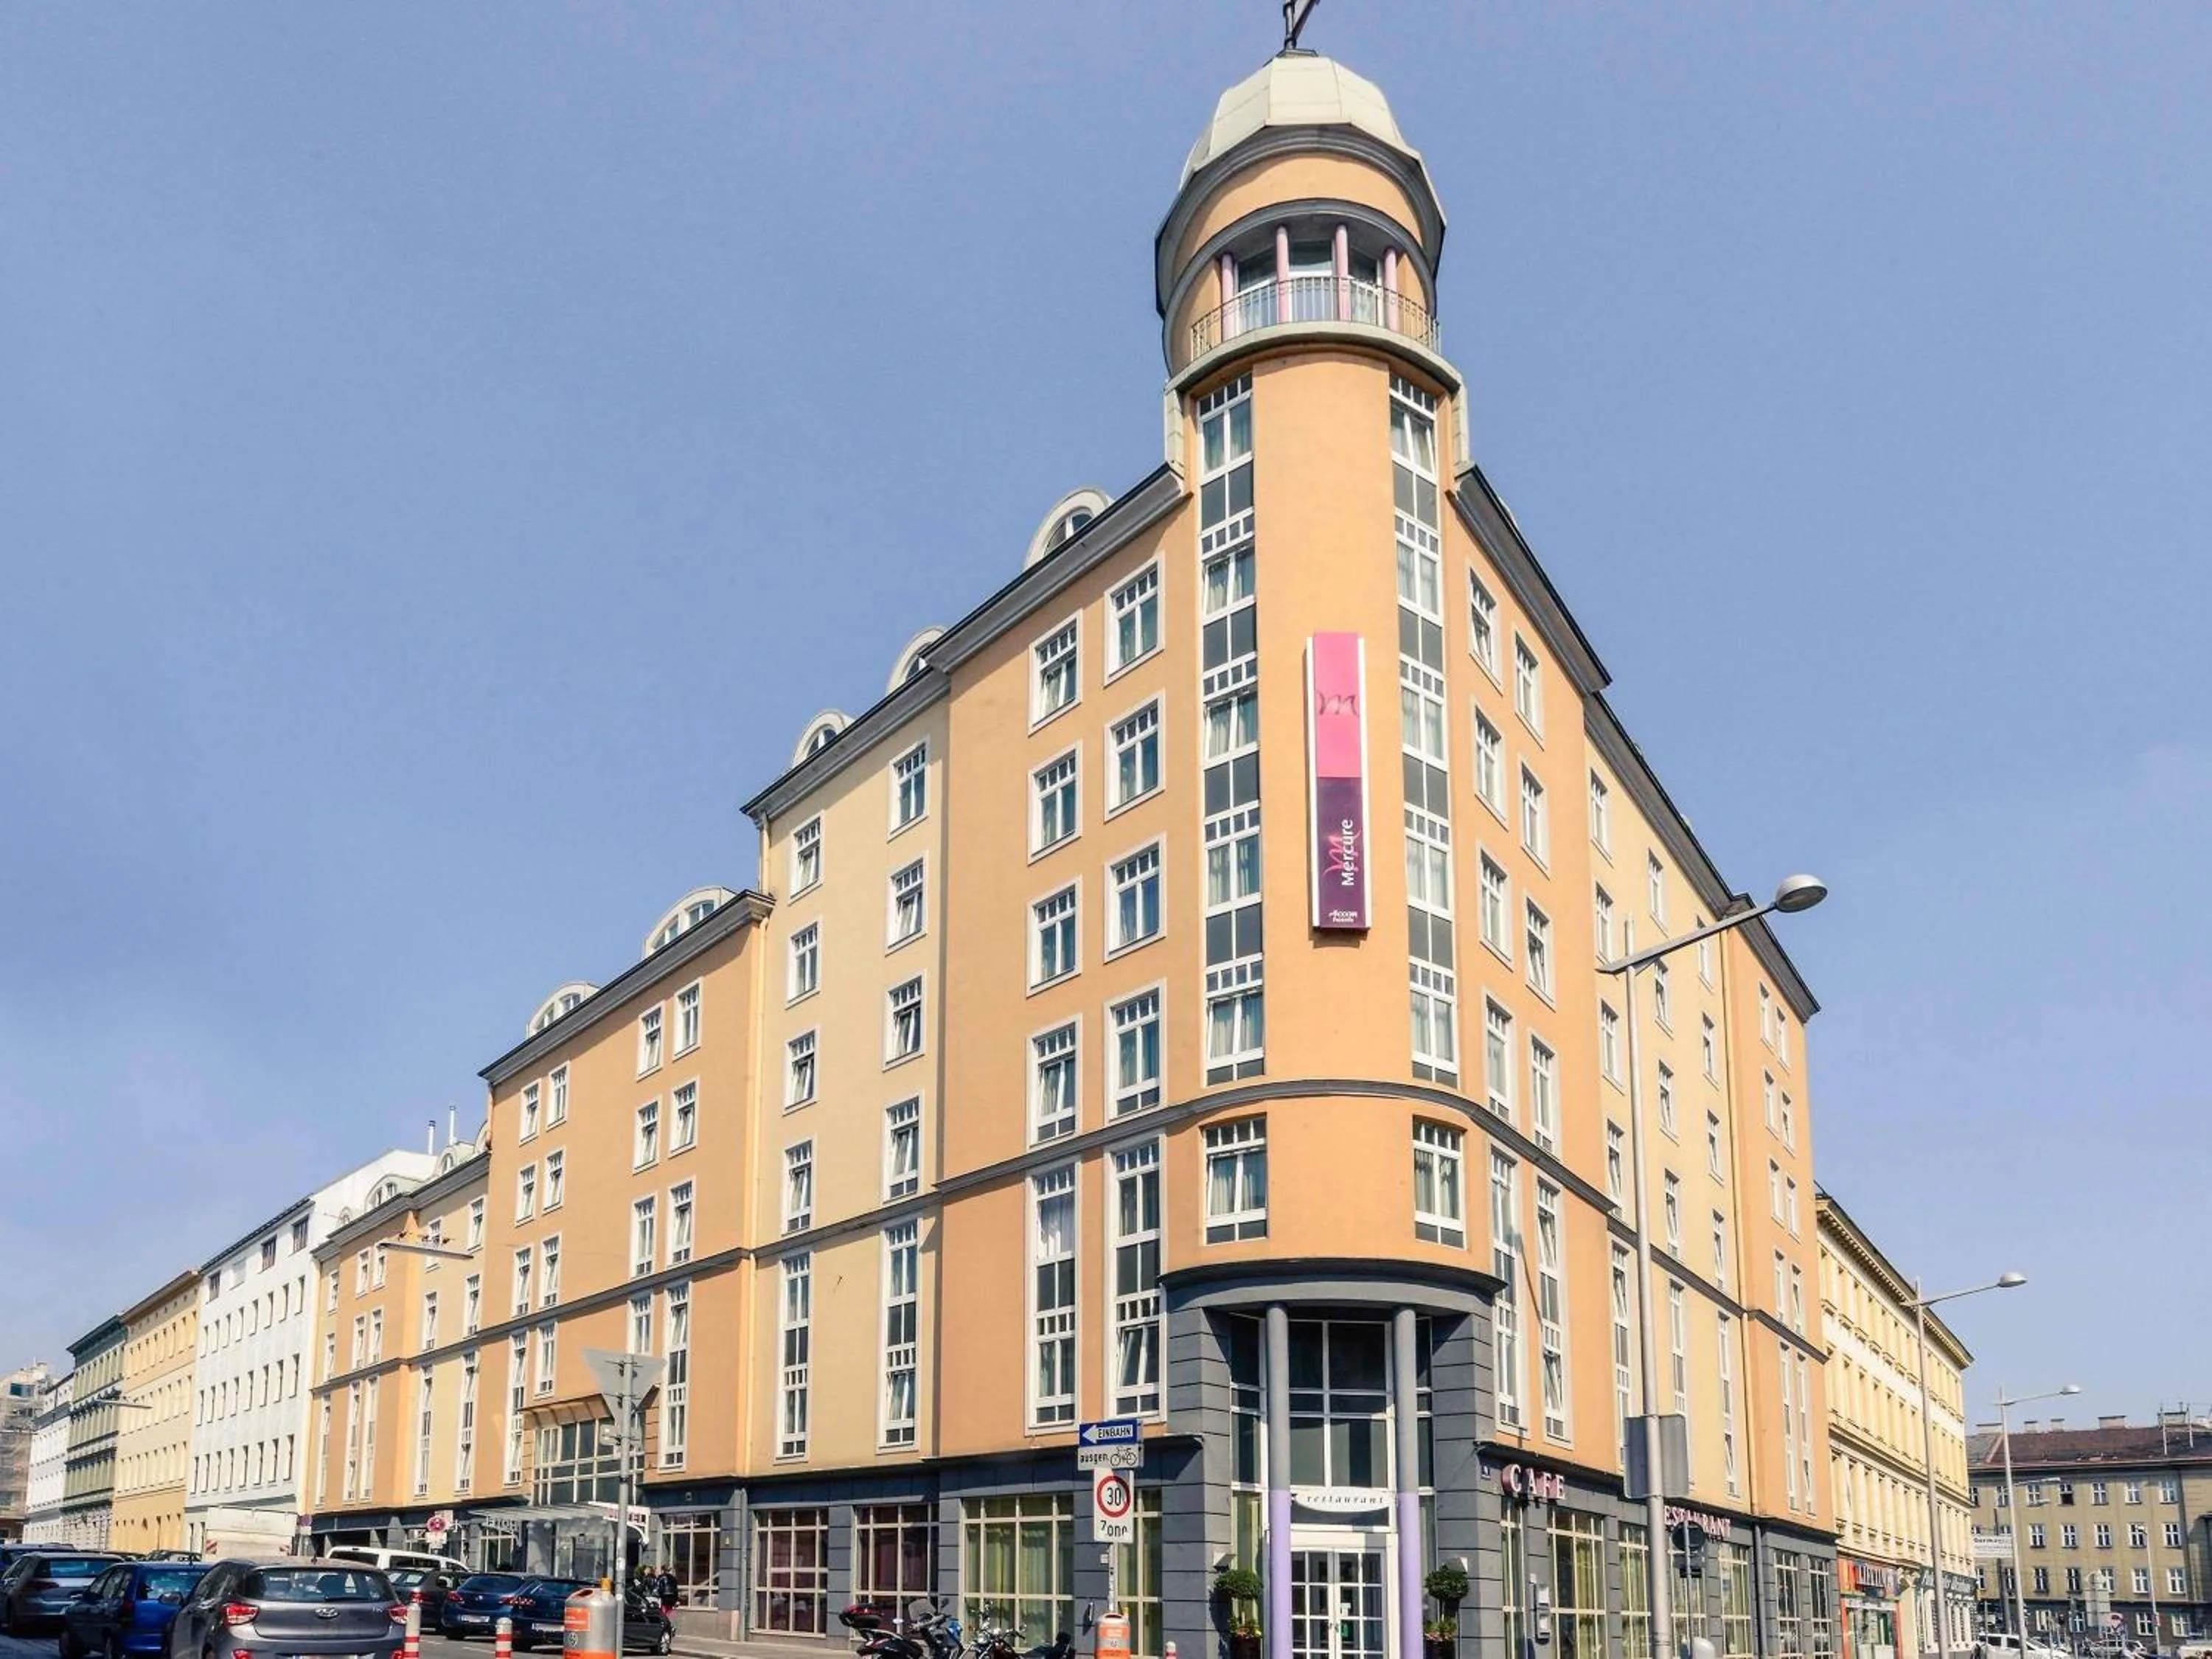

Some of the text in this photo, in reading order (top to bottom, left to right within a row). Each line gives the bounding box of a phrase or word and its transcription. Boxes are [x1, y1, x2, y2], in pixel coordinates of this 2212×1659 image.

[1341, 818, 1354, 886] Mercure
[1098, 1427, 1131, 1438] EINBAHN
[1510, 1464, 1565, 1500] CAFE
[1107, 1486, 1121, 1506] 30
[1306, 1495, 1384, 1504] restaurant
